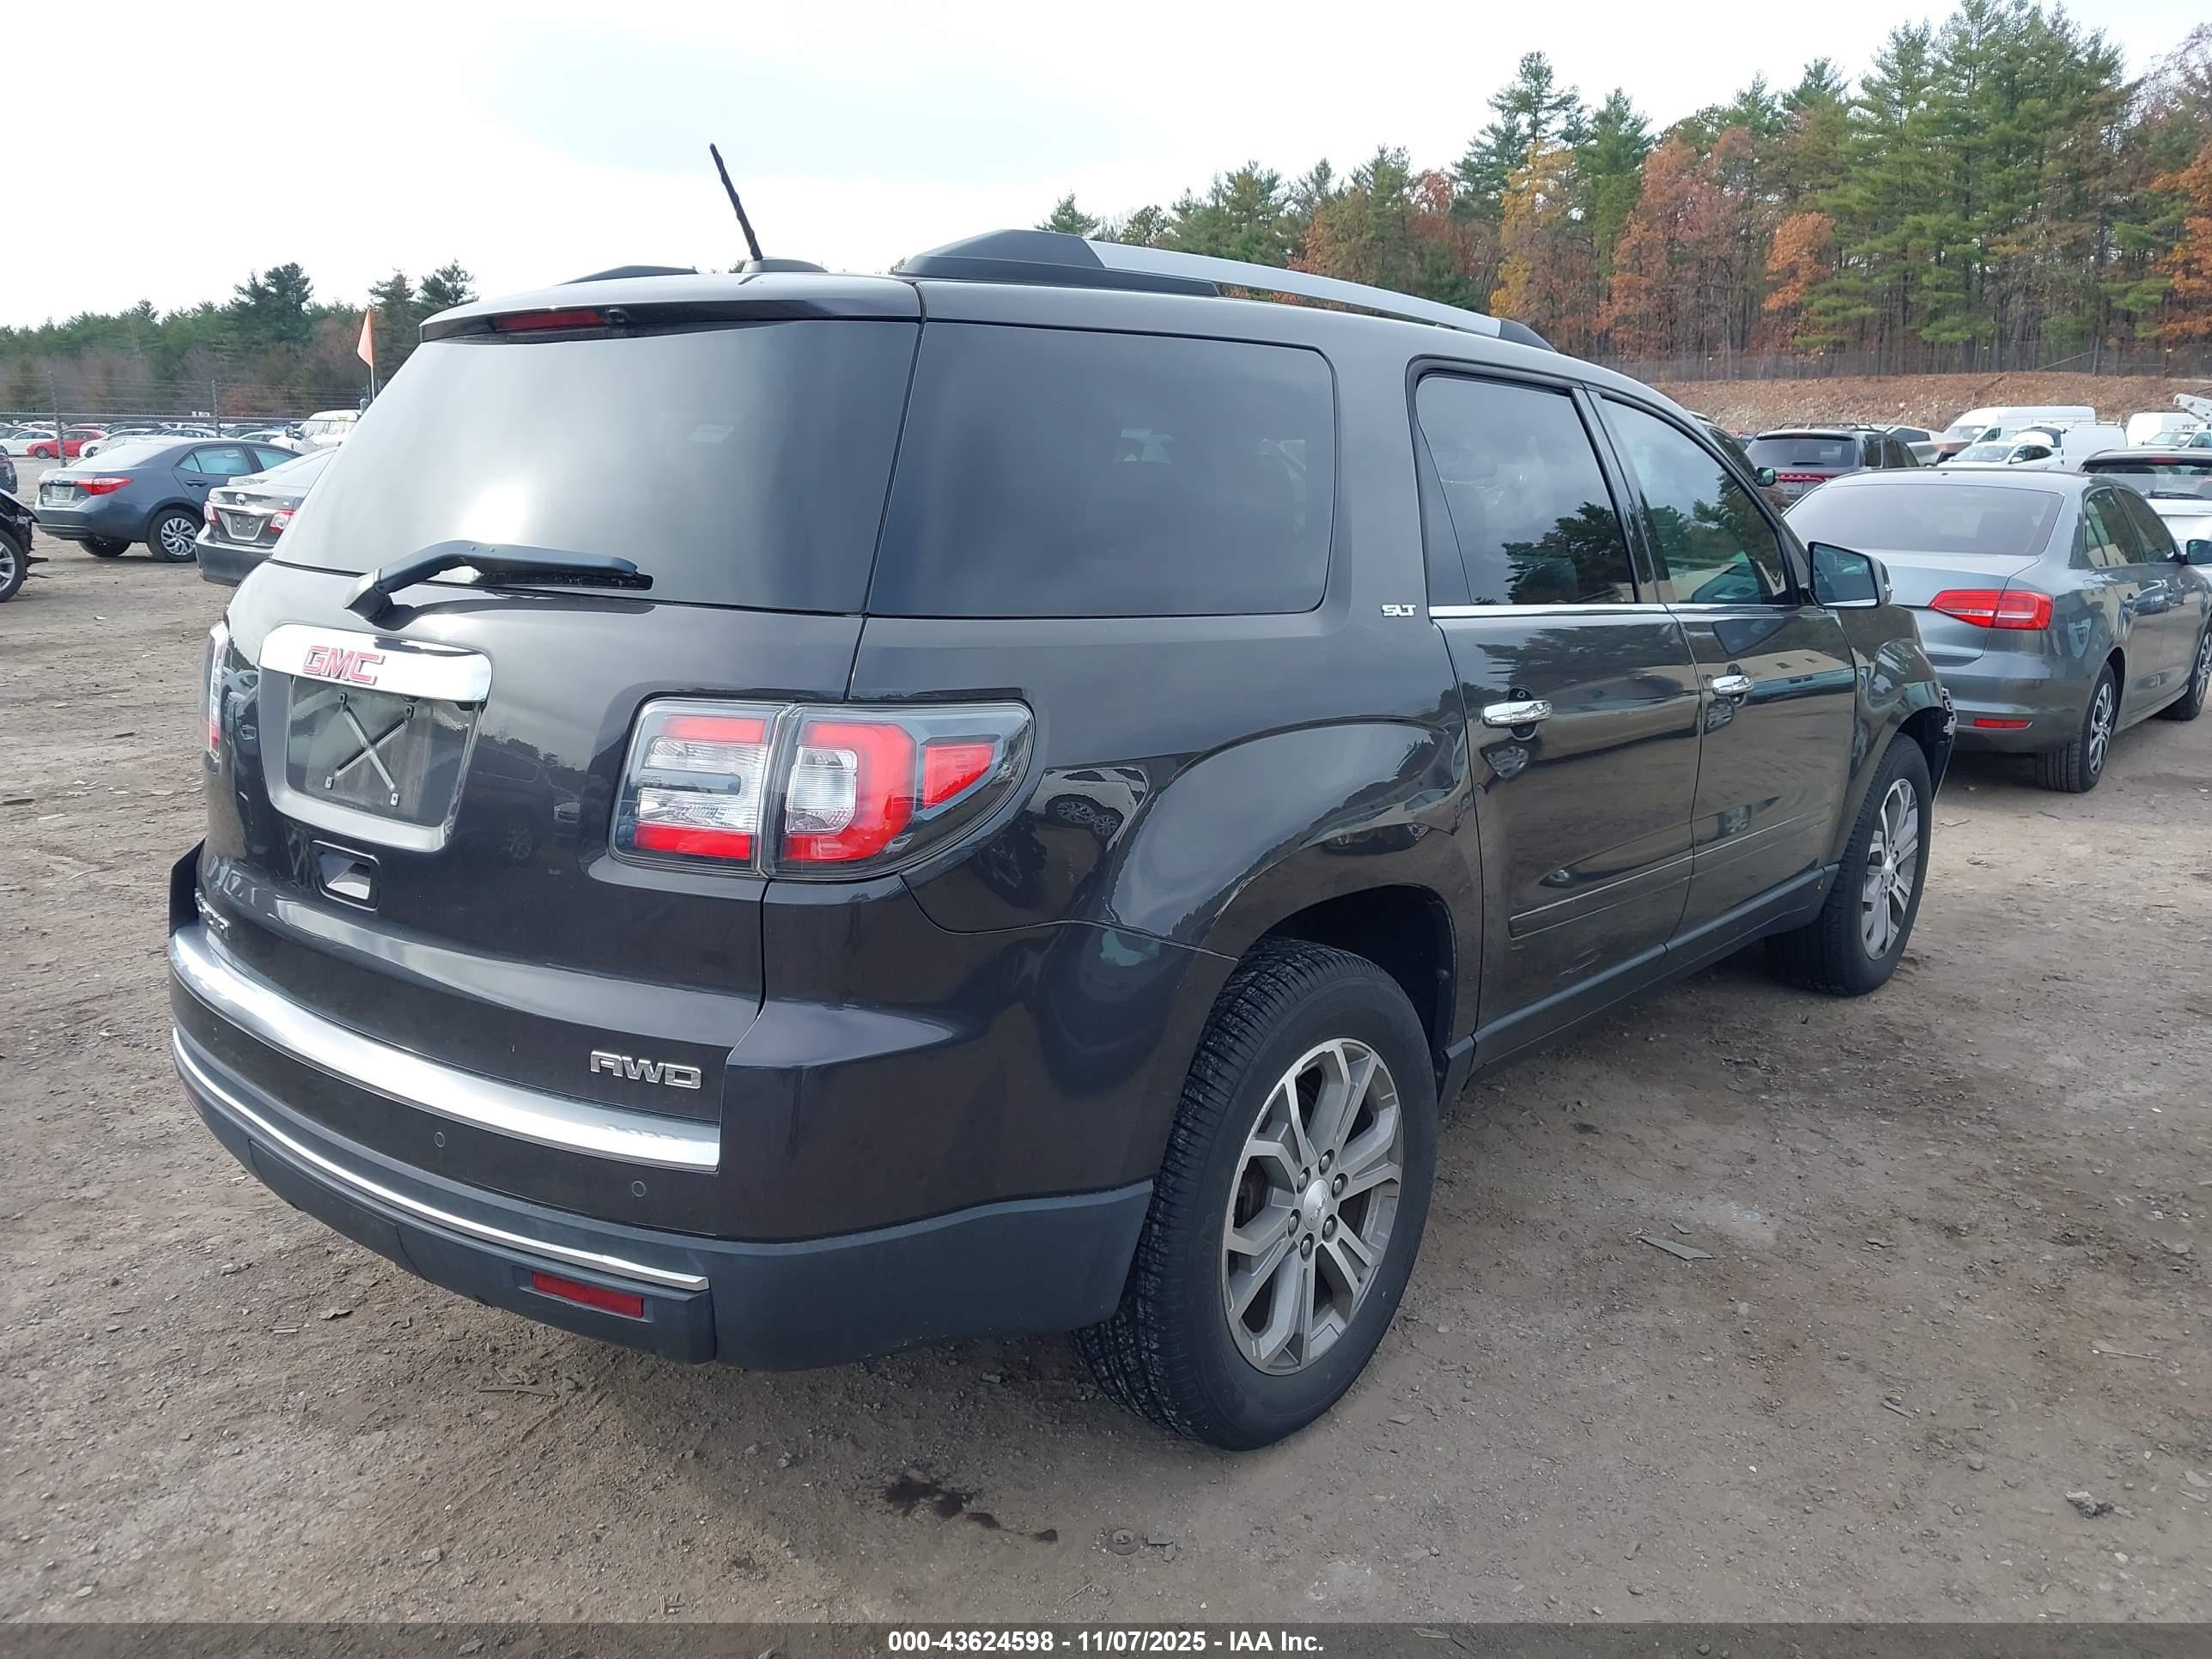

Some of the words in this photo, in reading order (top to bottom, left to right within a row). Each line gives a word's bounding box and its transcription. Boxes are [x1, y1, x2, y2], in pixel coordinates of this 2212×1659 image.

[1381, 604, 1417, 617] SLT
[301, 645, 386, 685] GMC
[590, 1050, 702, 1090] AWD
